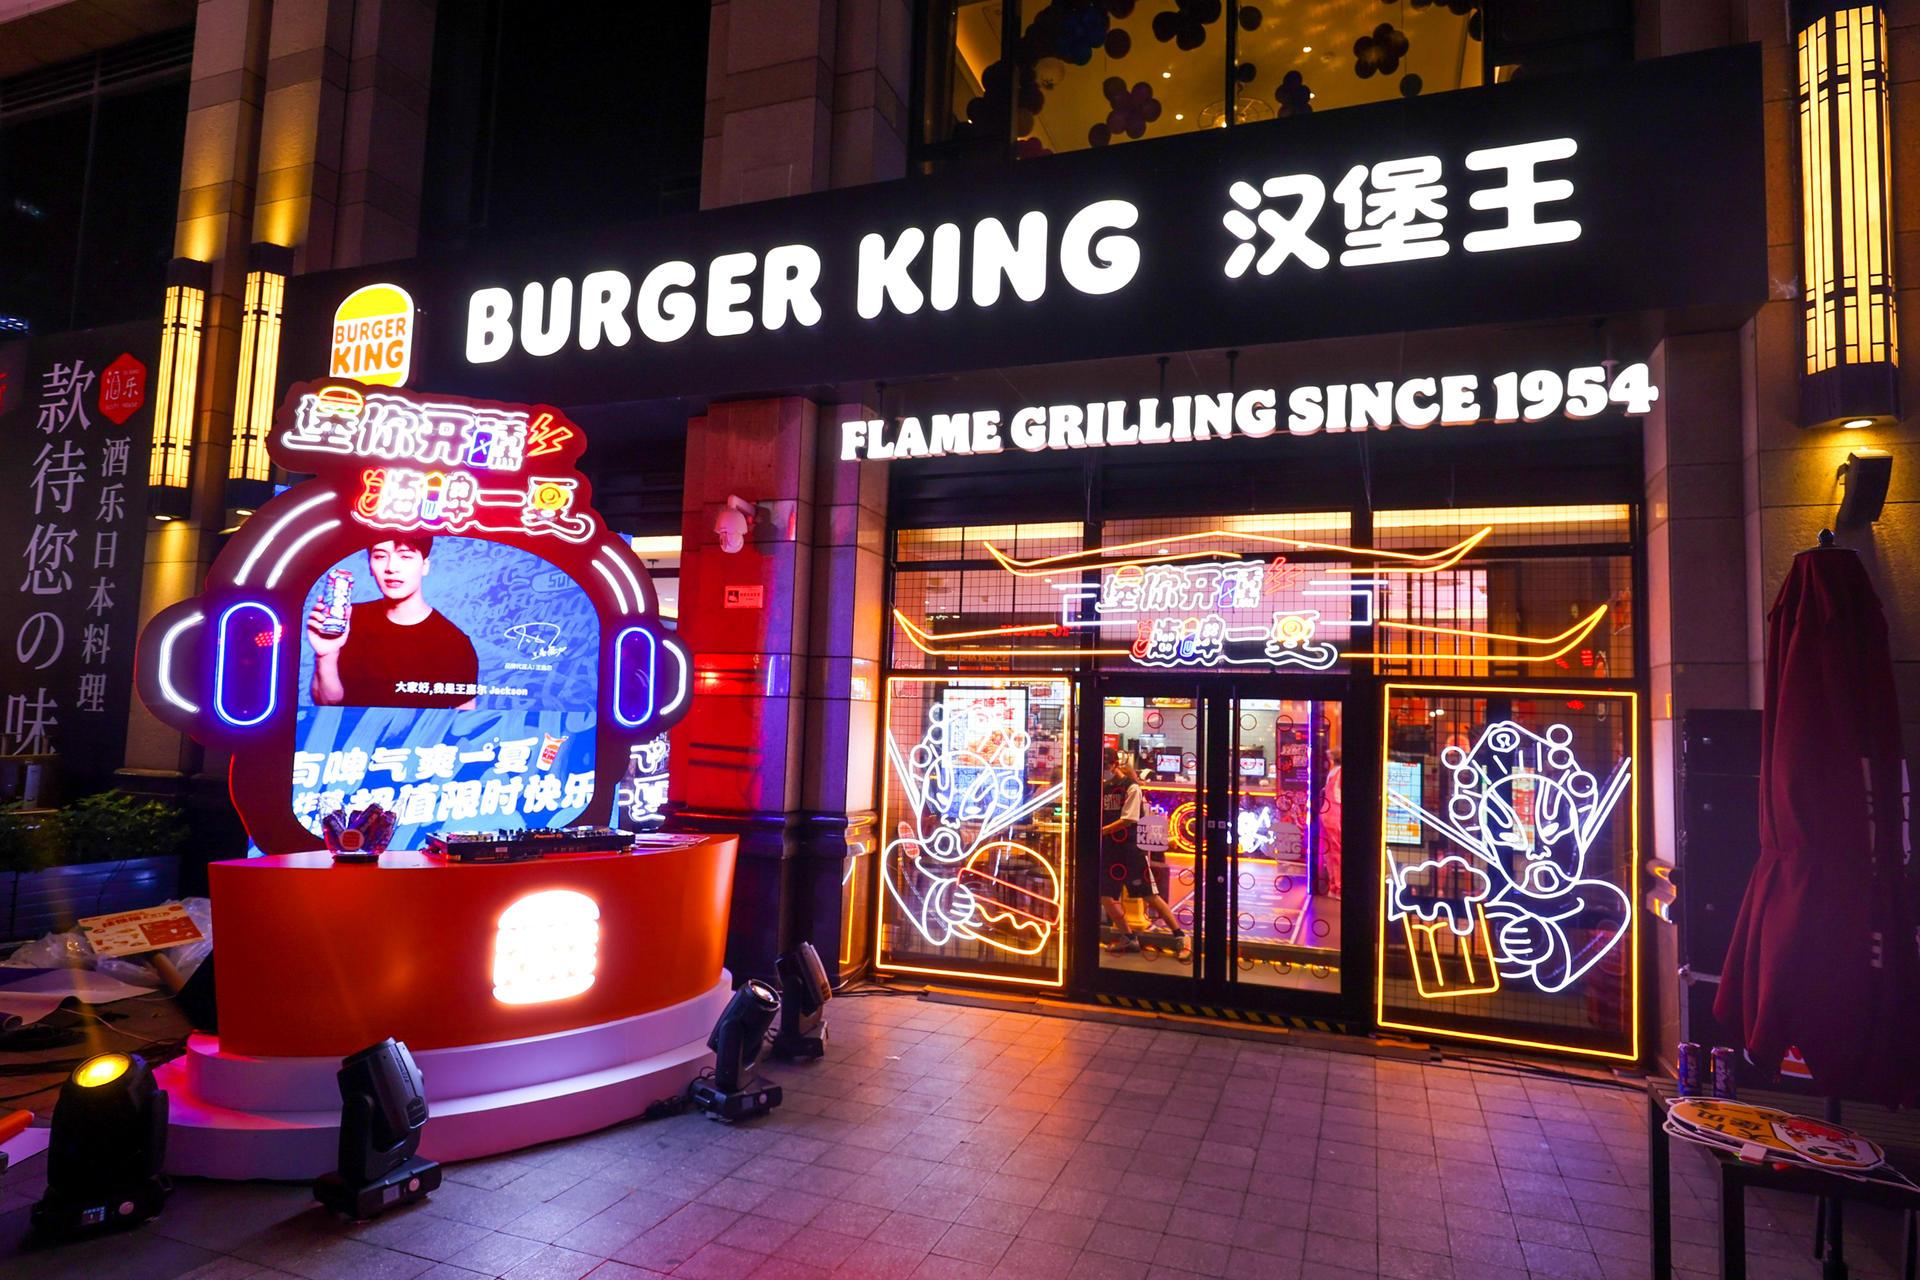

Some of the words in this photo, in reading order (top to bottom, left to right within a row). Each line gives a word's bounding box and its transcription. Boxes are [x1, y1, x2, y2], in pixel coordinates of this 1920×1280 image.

[1222, 137, 1582, 279] 汉堡王
[334, 317, 406, 345] BURGER
[466, 243, 822, 364] BURGER
[857, 199, 1141, 320] KING
[332, 339, 404, 375] KING
[840, 410, 1003, 461] FLAME
[1010, 389, 1277, 452] GRILLING
[1288, 374, 1482, 436] SINCE
[1492, 362, 1660, 424] 1954
[76, 436, 132, 713] 酒乐日本料理
[488, 685, 528, 696] Jackson
